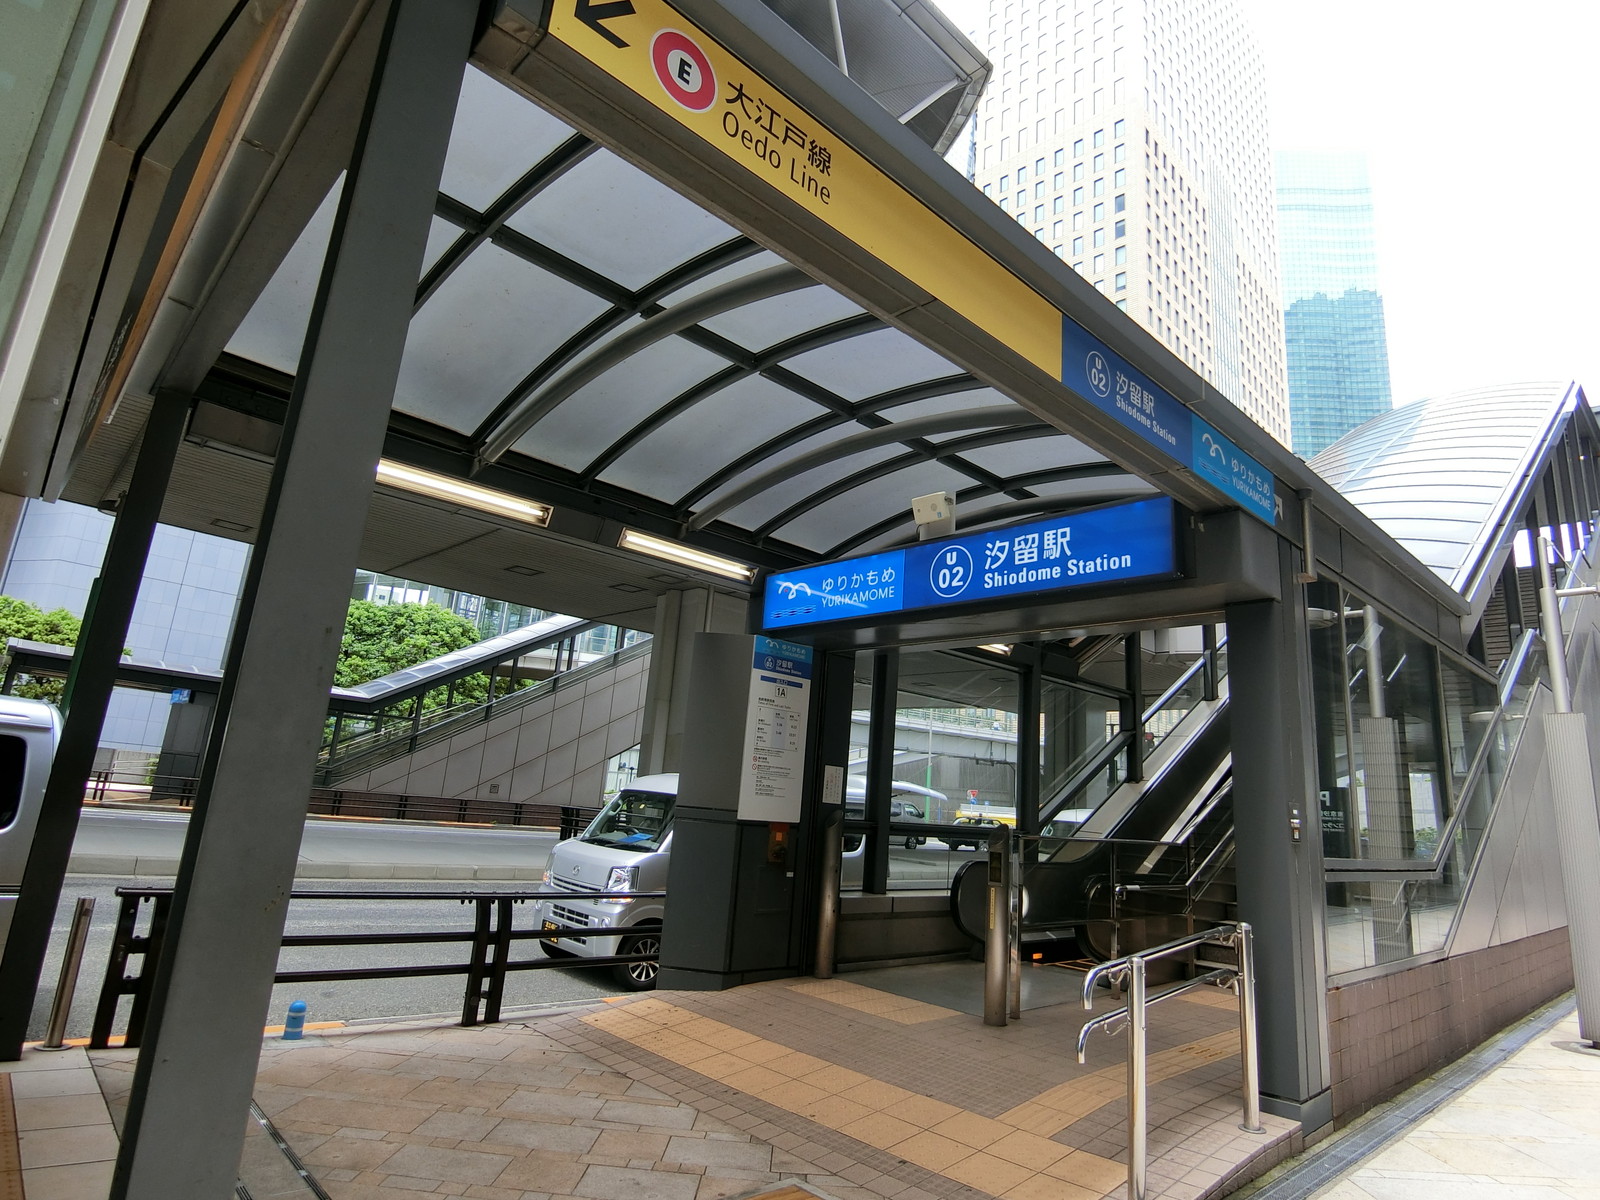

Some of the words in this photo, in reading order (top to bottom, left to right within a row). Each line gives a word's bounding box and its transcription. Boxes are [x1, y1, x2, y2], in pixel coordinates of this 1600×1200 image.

[678, 57, 692, 85] E
[725, 81, 831, 177] 大江戸線
[722, 111, 782, 169] Oedo
[790, 157, 831, 205] Line
[1095, 357, 1102, 370] U
[1091, 370, 1106, 392] 02
[1116, 370, 1155, 417] 汐留駅
[1116, 395, 1151, 429] Shiodome
[1152, 421, 1176, 446] Station
[1231, 457, 1271, 497] ゆりかもめ
[1231, 475, 1271, 512] YURIKAMOME
[946, 553, 957, 566] U
[984, 526, 1072, 570] 汐留駅
[821, 566, 896, 594] ゆりかもめ
[938, 566, 964, 589] 02
[983, 566, 1062, 590] Shiodome
[1066, 554, 1132, 577] Station
[821, 586, 895, 608] YURIKAMOME
[777, 687, 786, 697] 1A
